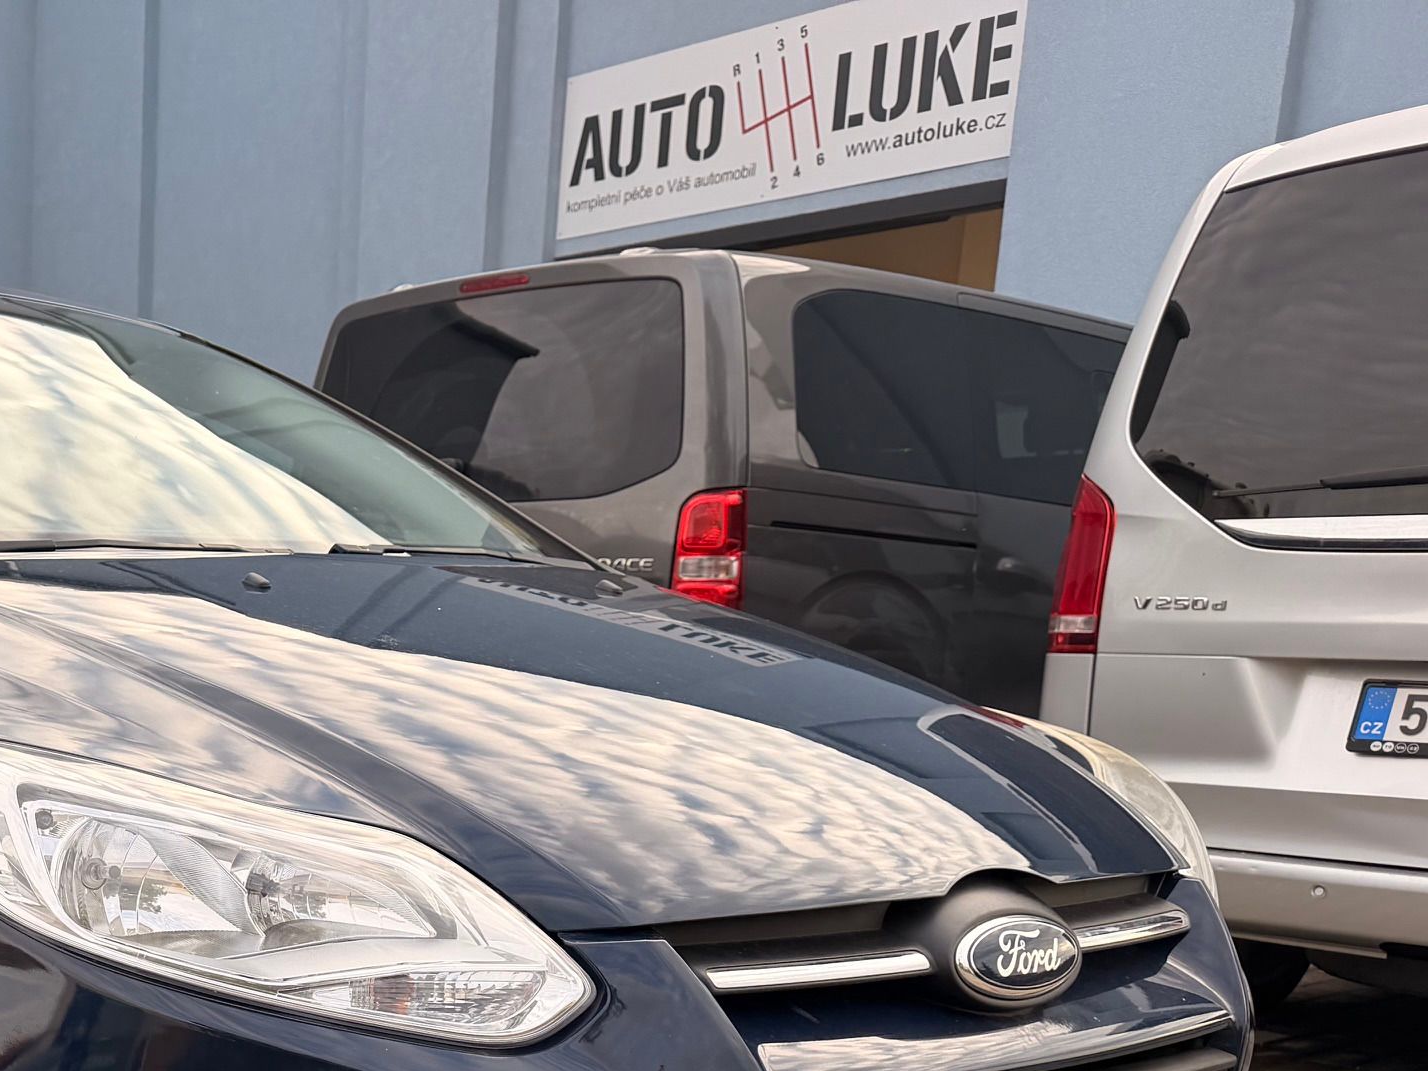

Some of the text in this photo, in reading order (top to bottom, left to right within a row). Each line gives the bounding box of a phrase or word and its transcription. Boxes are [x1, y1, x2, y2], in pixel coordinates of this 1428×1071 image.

[733, 25, 808, 77] R 1 3 5
[569, 10, 1019, 187] AUTO LUKE
[845, 112, 1007, 159] www.autoluke.cz
[655, 185, 664, 196] o
[770, 153, 825, 189] 2 4 6
[1360, 721, 1384, 734] CZ
[997, 929, 1062, 977] Ford
